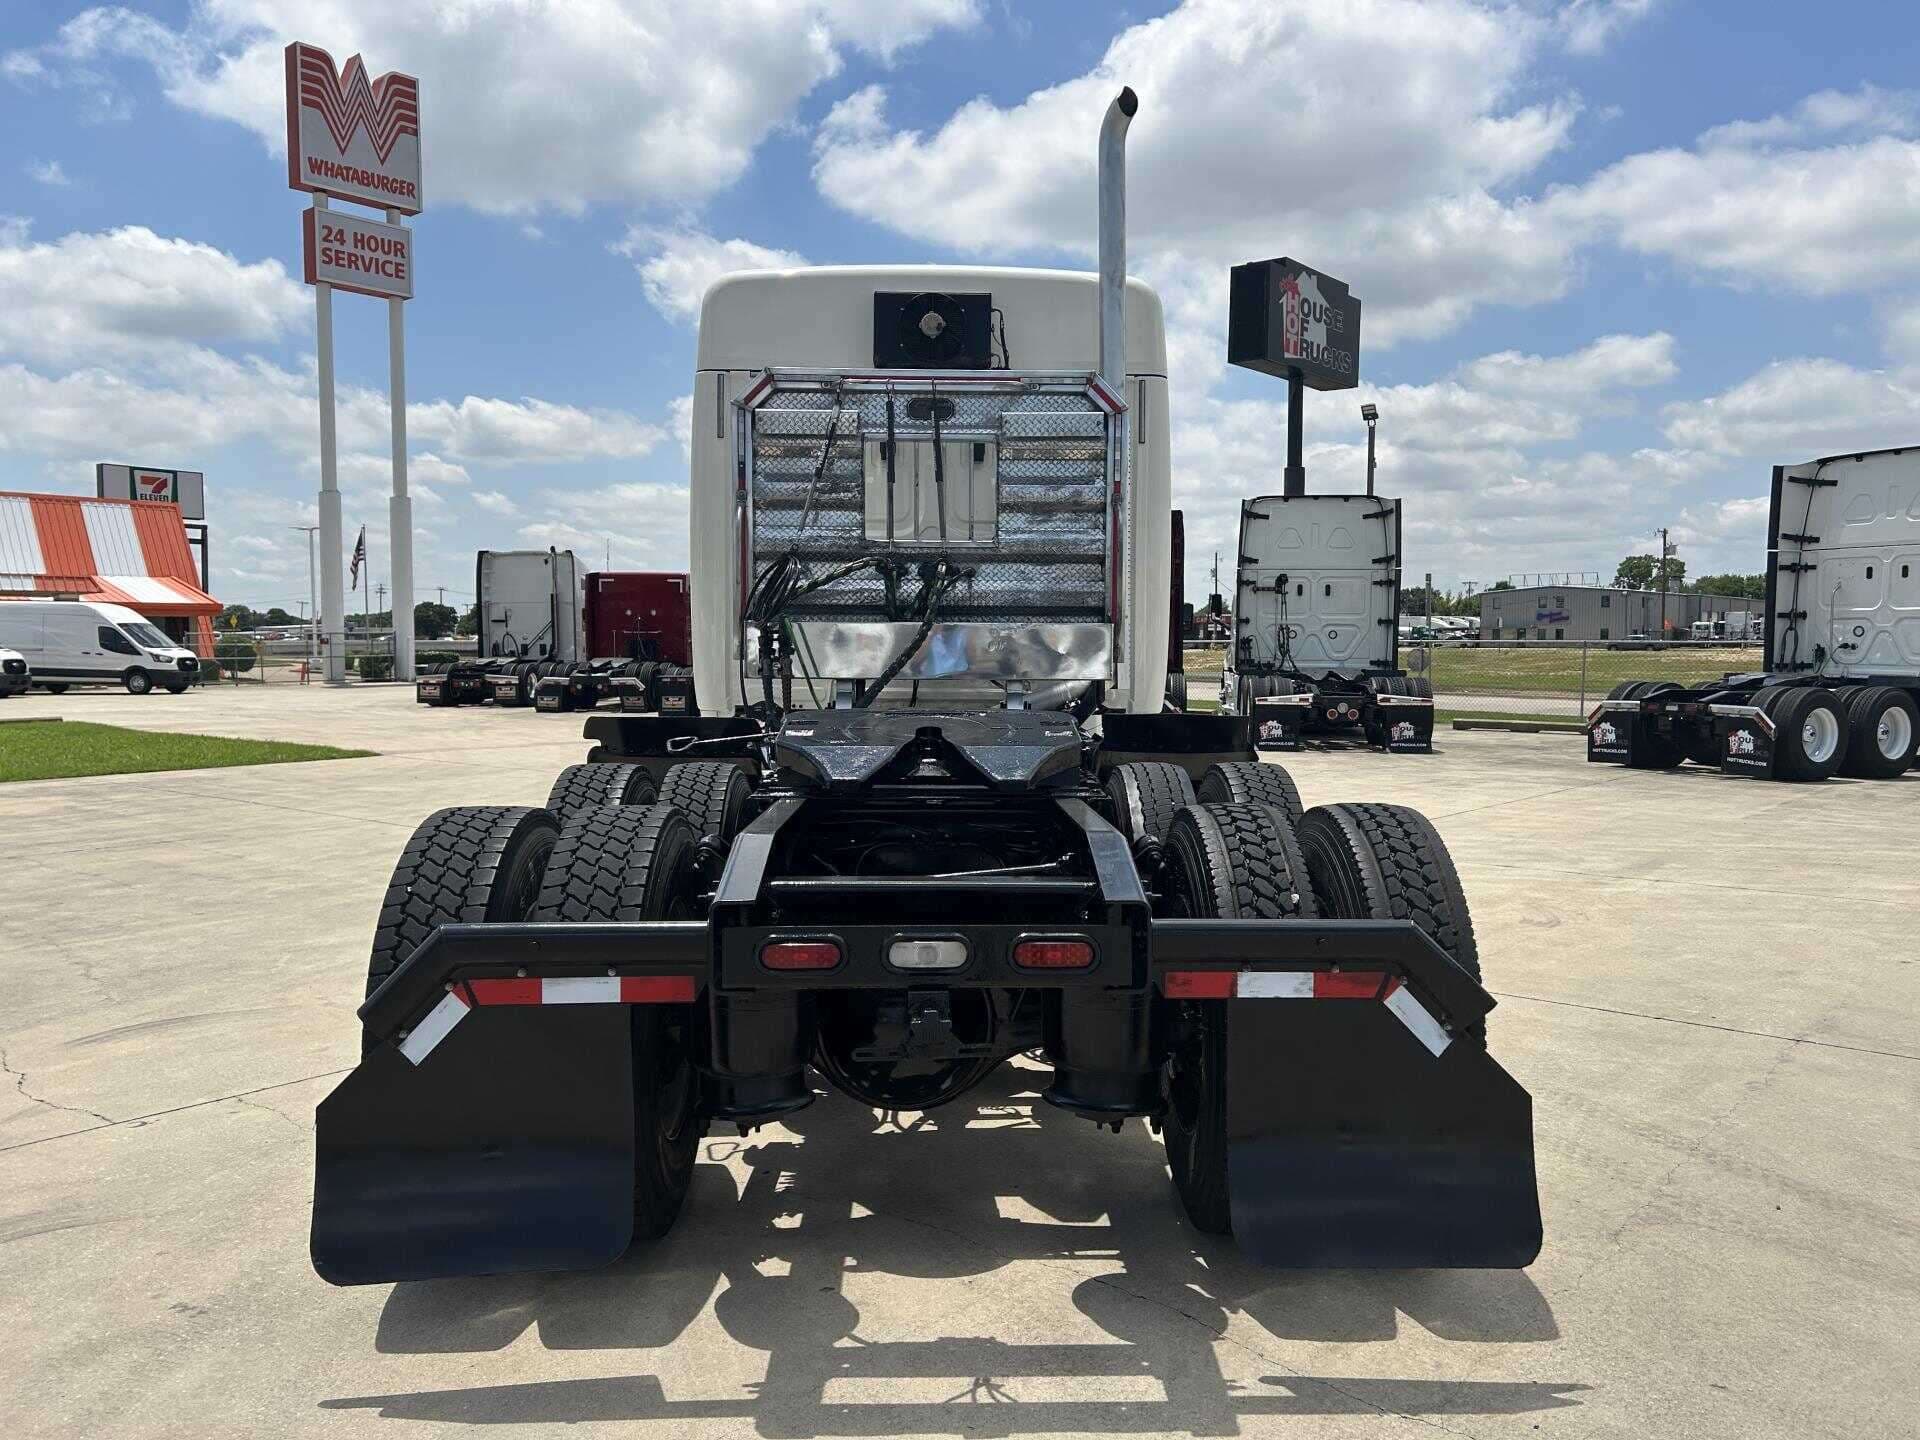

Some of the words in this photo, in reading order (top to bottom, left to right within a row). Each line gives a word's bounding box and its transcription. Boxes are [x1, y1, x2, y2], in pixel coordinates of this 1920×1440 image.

[307, 155, 417, 200] WHATABURGER
[321, 224, 346, 246] 24
[352, 231, 406, 259] HOUR
[321, 247, 406, 280] SERVICE
[140, 475, 168, 494] 7
